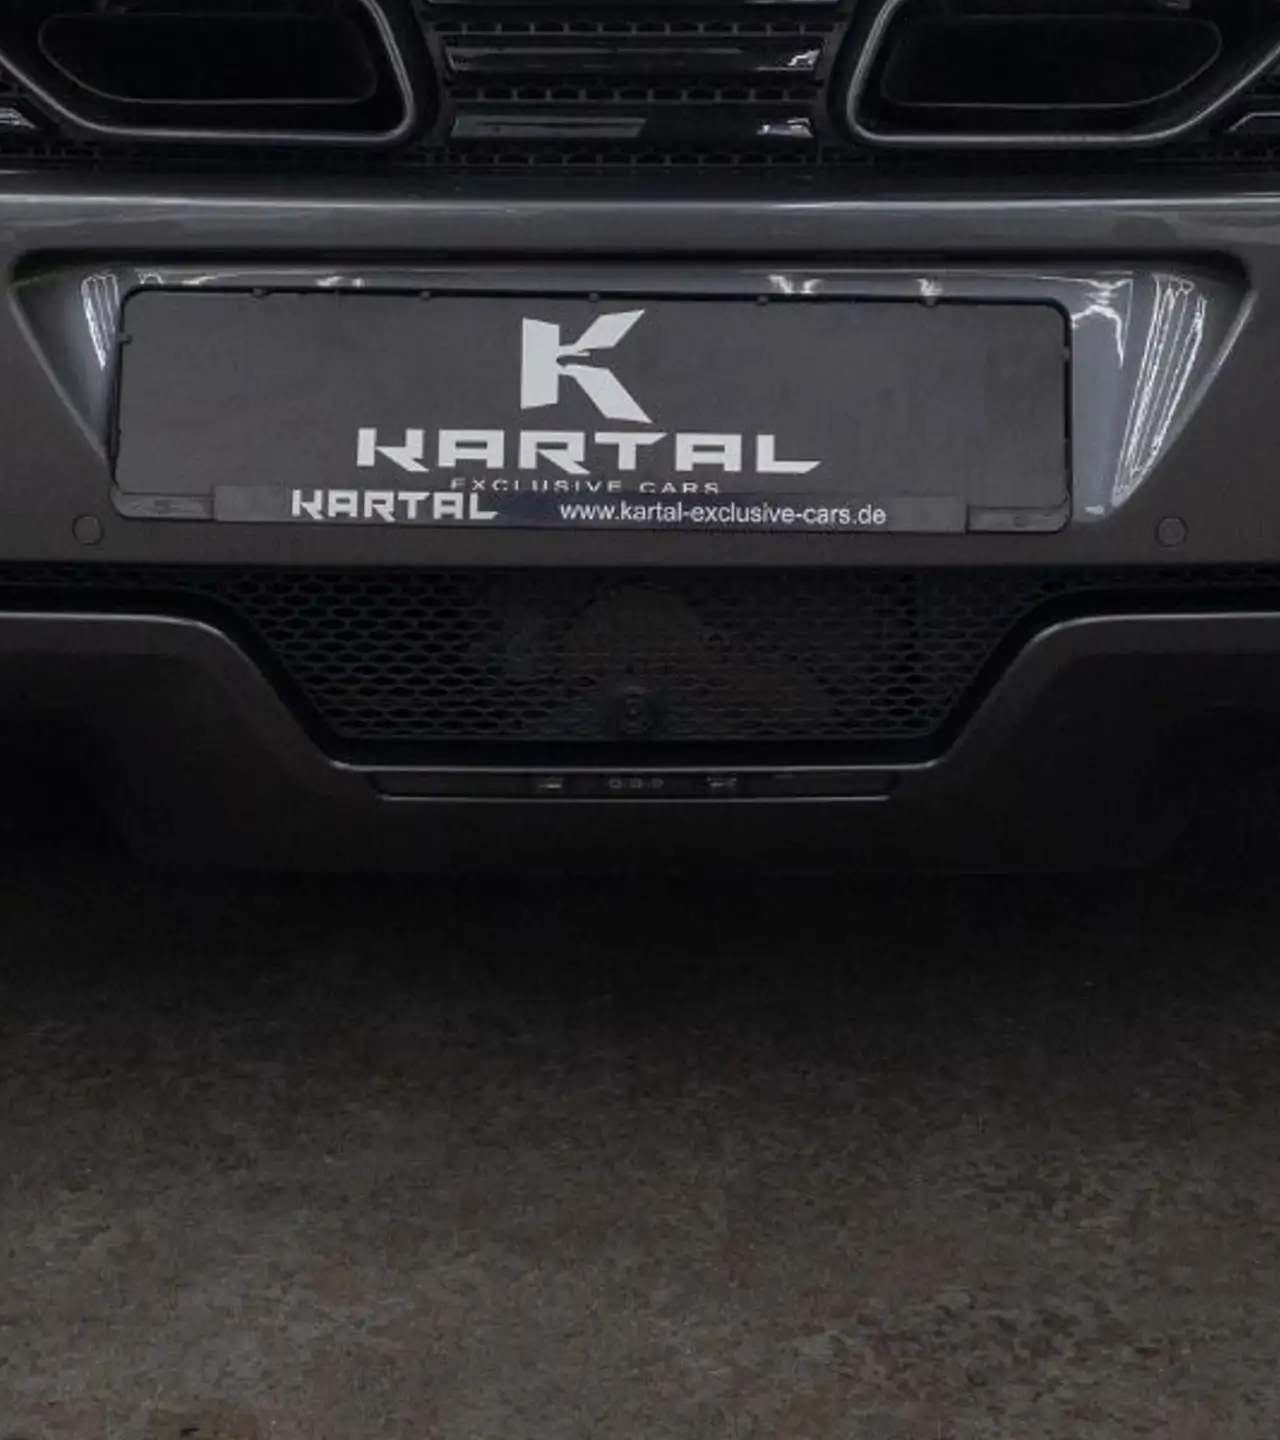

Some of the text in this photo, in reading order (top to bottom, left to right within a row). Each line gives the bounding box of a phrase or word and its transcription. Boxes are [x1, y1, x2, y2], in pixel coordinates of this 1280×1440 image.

[356, 427, 822, 476] KARTAL
[638, 481, 721, 495] CARS
[290, 487, 500, 523] KARTAL
[560, 500, 889, 527] www.kartal-exclusive-cars.de
